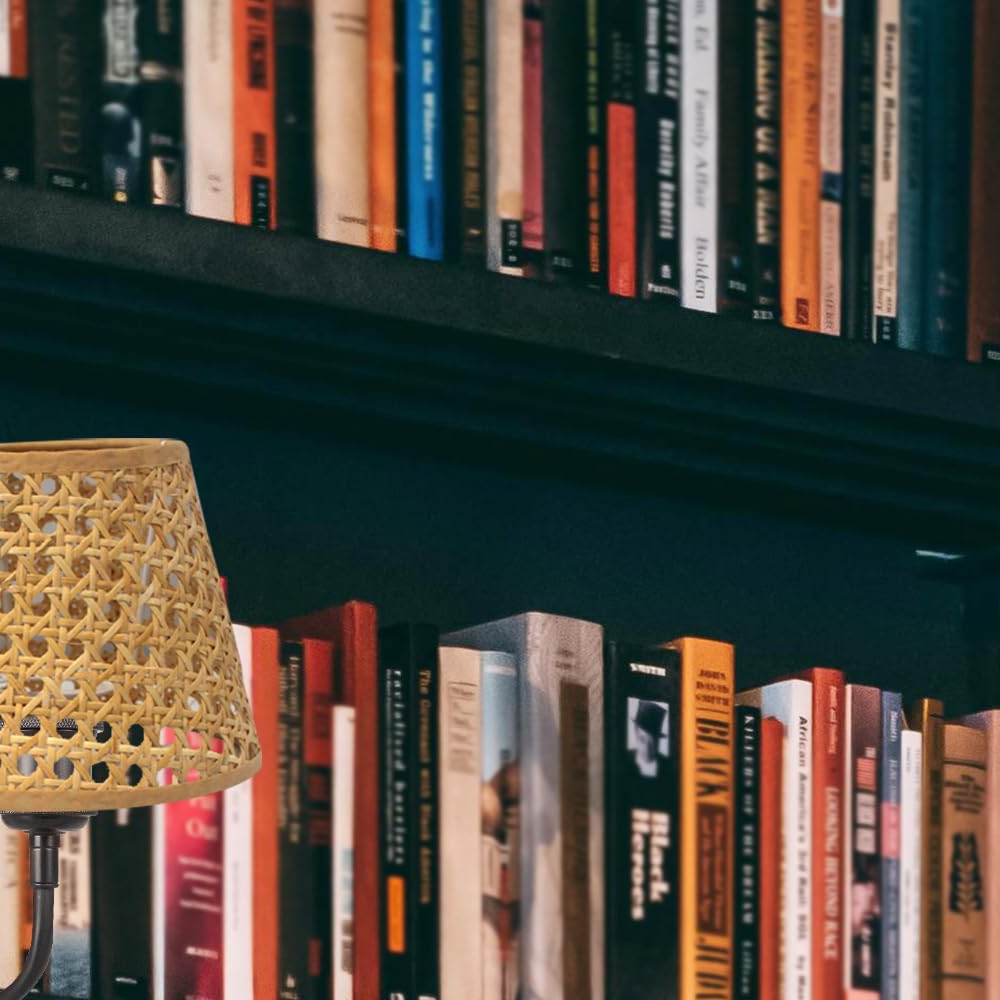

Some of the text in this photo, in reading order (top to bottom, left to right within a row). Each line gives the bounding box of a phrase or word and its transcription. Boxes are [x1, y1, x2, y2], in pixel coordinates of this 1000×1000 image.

[423, 92, 436, 181] Wilderness
[881, 23, 898, 182] Stanley Robinson
[658, 181, 677, 239] Roberts
[693, 88, 711, 301] Family Affair Bolden
[419, 669, 432, 694] The
[419, 699, 432, 764] Covenant
[695, 718, 731, 800] BLACK
[742, 715, 756, 786] KILLERS
[796, 716, 809, 767] African
[419, 804, 432, 840] Black
[742, 794, 756, 815] OF
[796, 771, 809, 843] America's
[630, 808, 652, 920] Heroes
[650, 812, 671, 901] Black
[742, 824, 756, 855] THE
[823, 786, 840, 959] LOOKING BEYOND RACE
[419, 847, 432, 904] America
[742, 864, 756, 925] DREAM
